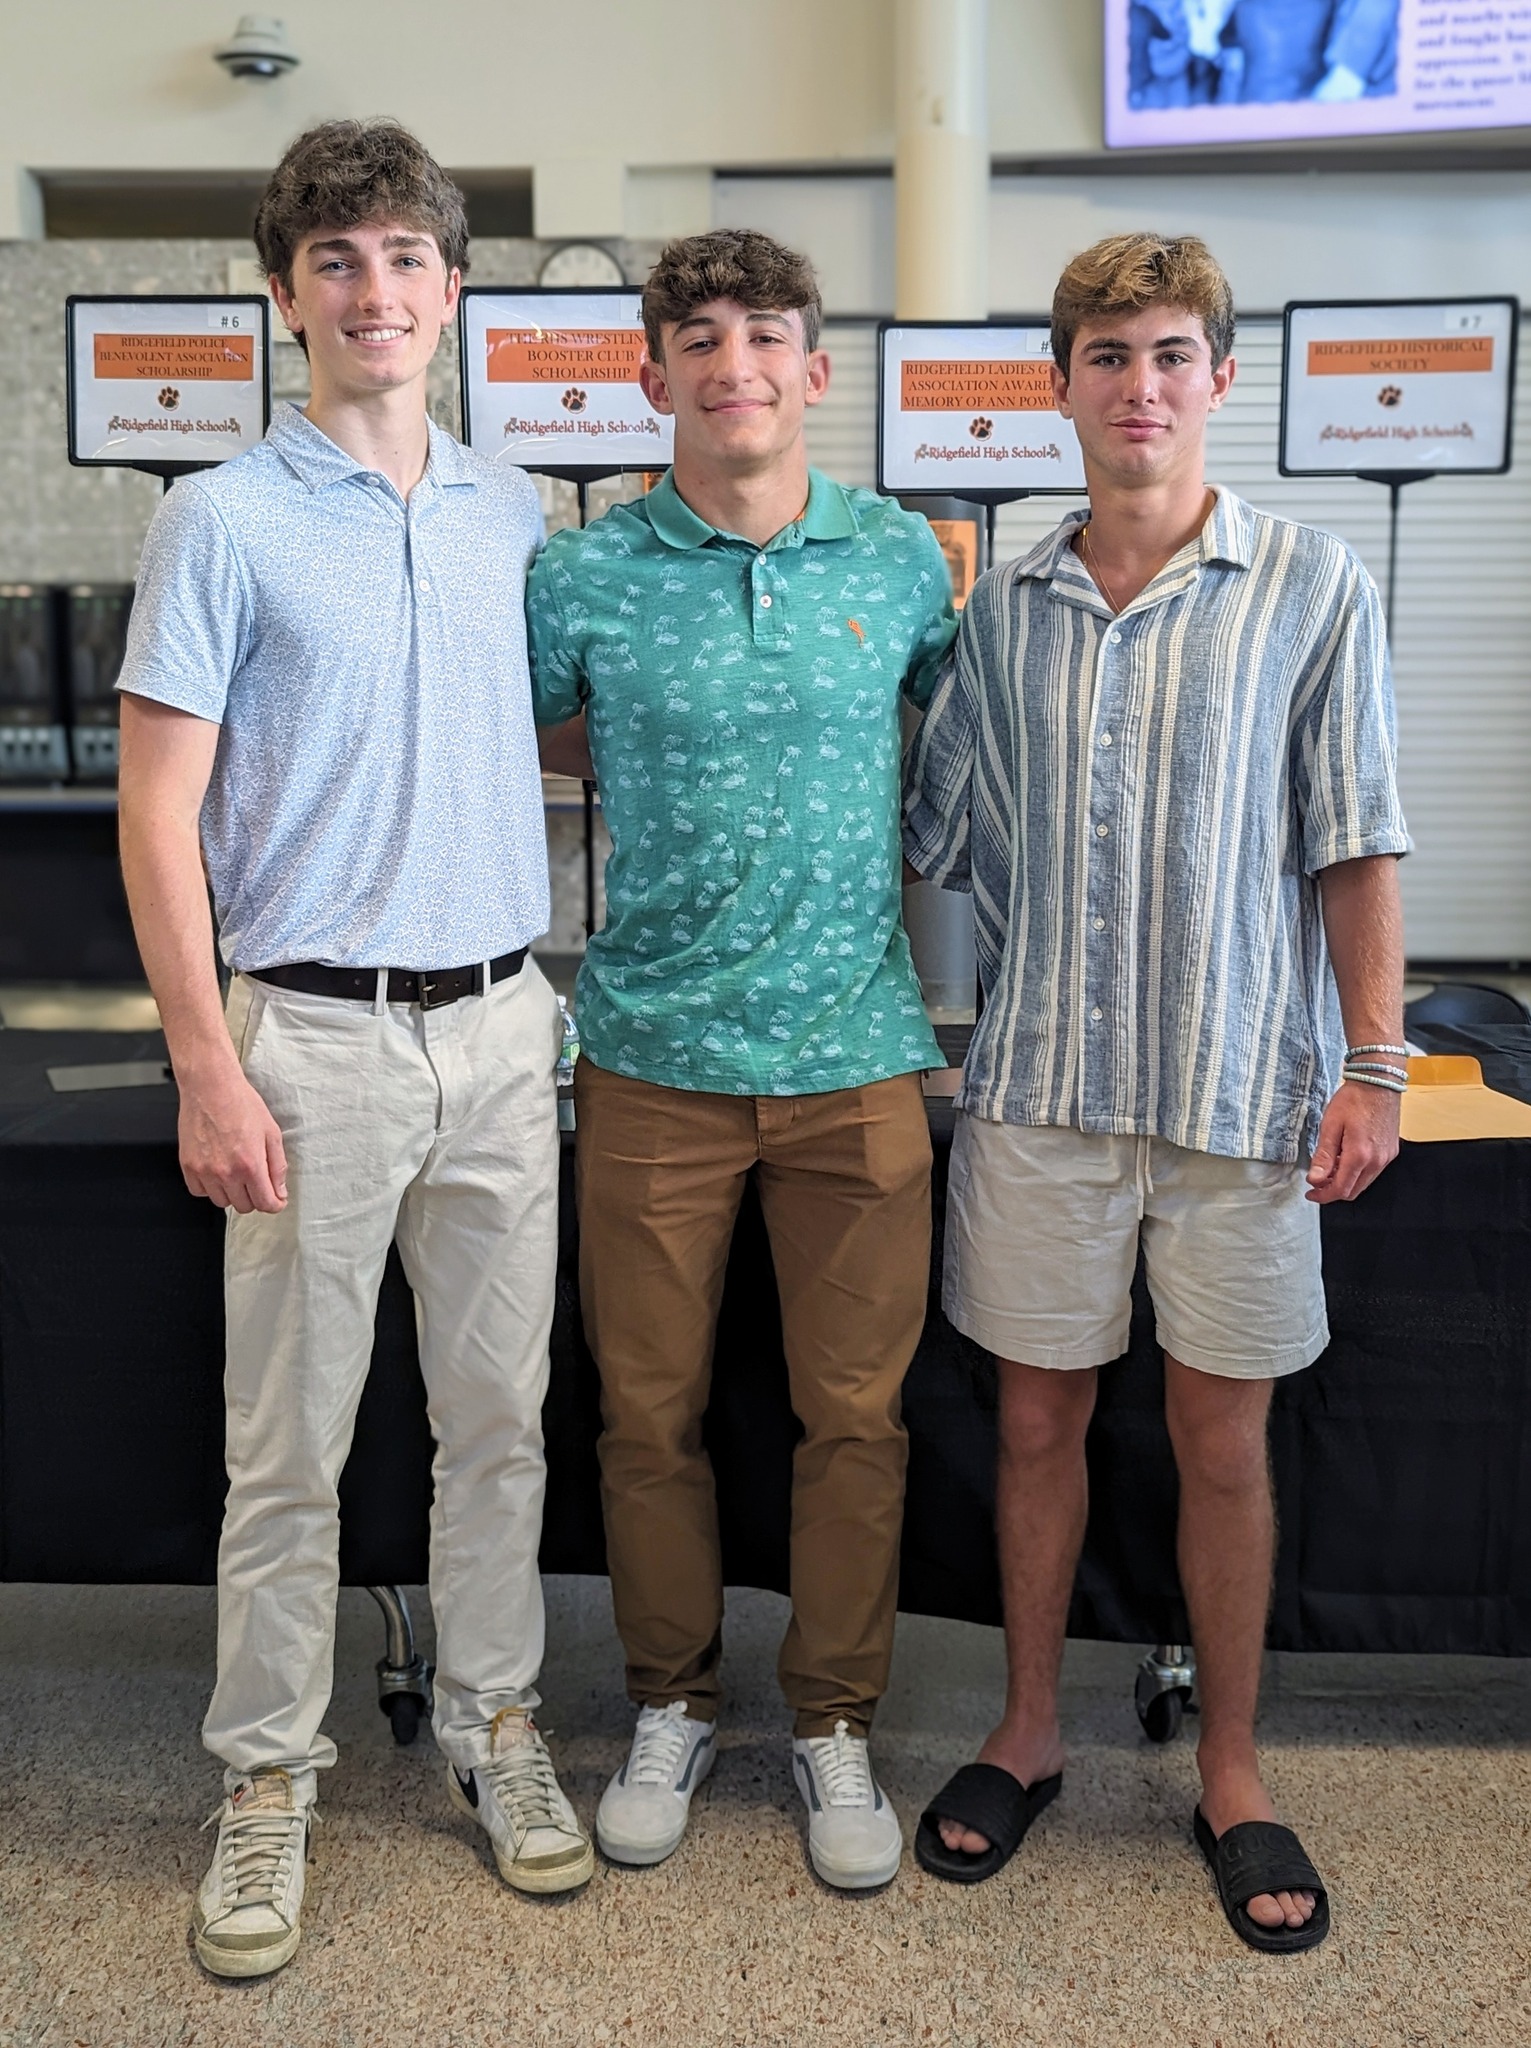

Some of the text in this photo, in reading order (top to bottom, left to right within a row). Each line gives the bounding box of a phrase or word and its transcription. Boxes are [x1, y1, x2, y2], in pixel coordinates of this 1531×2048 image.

[232, 315, 240, 328] 6
[121, 337, 228, 348] RIDGEFIELD POLICE
[572, 332, 645, 345] WRESTLIN
[1314, 339, 1487, 355] RIDGEFIELD HISTORICAL
[99, 352, 173, 362] BENEVOLENT
[527, 350, 635, 362] BOOSTER CLUB
[905, 363, 985, 375] RIDGEFIELD
[988, 363, 1035, 375] LADIES
[1369, 358, 1430, 370] SOCIETY
[136, 366, 213, 377] SCHOLARSHIP
[532, 367, 631, 379] SCHOLARSHIP
[908, 380, 998, 391] ASSOCIATION
[903, 396, 963, 408] MEMORY
[965, 396, 985, 407] OF
[986, 396, 1016, 407] ANN
[121, 417, 228, 435] Ridgefield High School
[519, 420, 645, 437] Ridgefield High School
[1391, 424, 1418, 441] High
[929, 446, 1047, 462] Ridgefield High School
